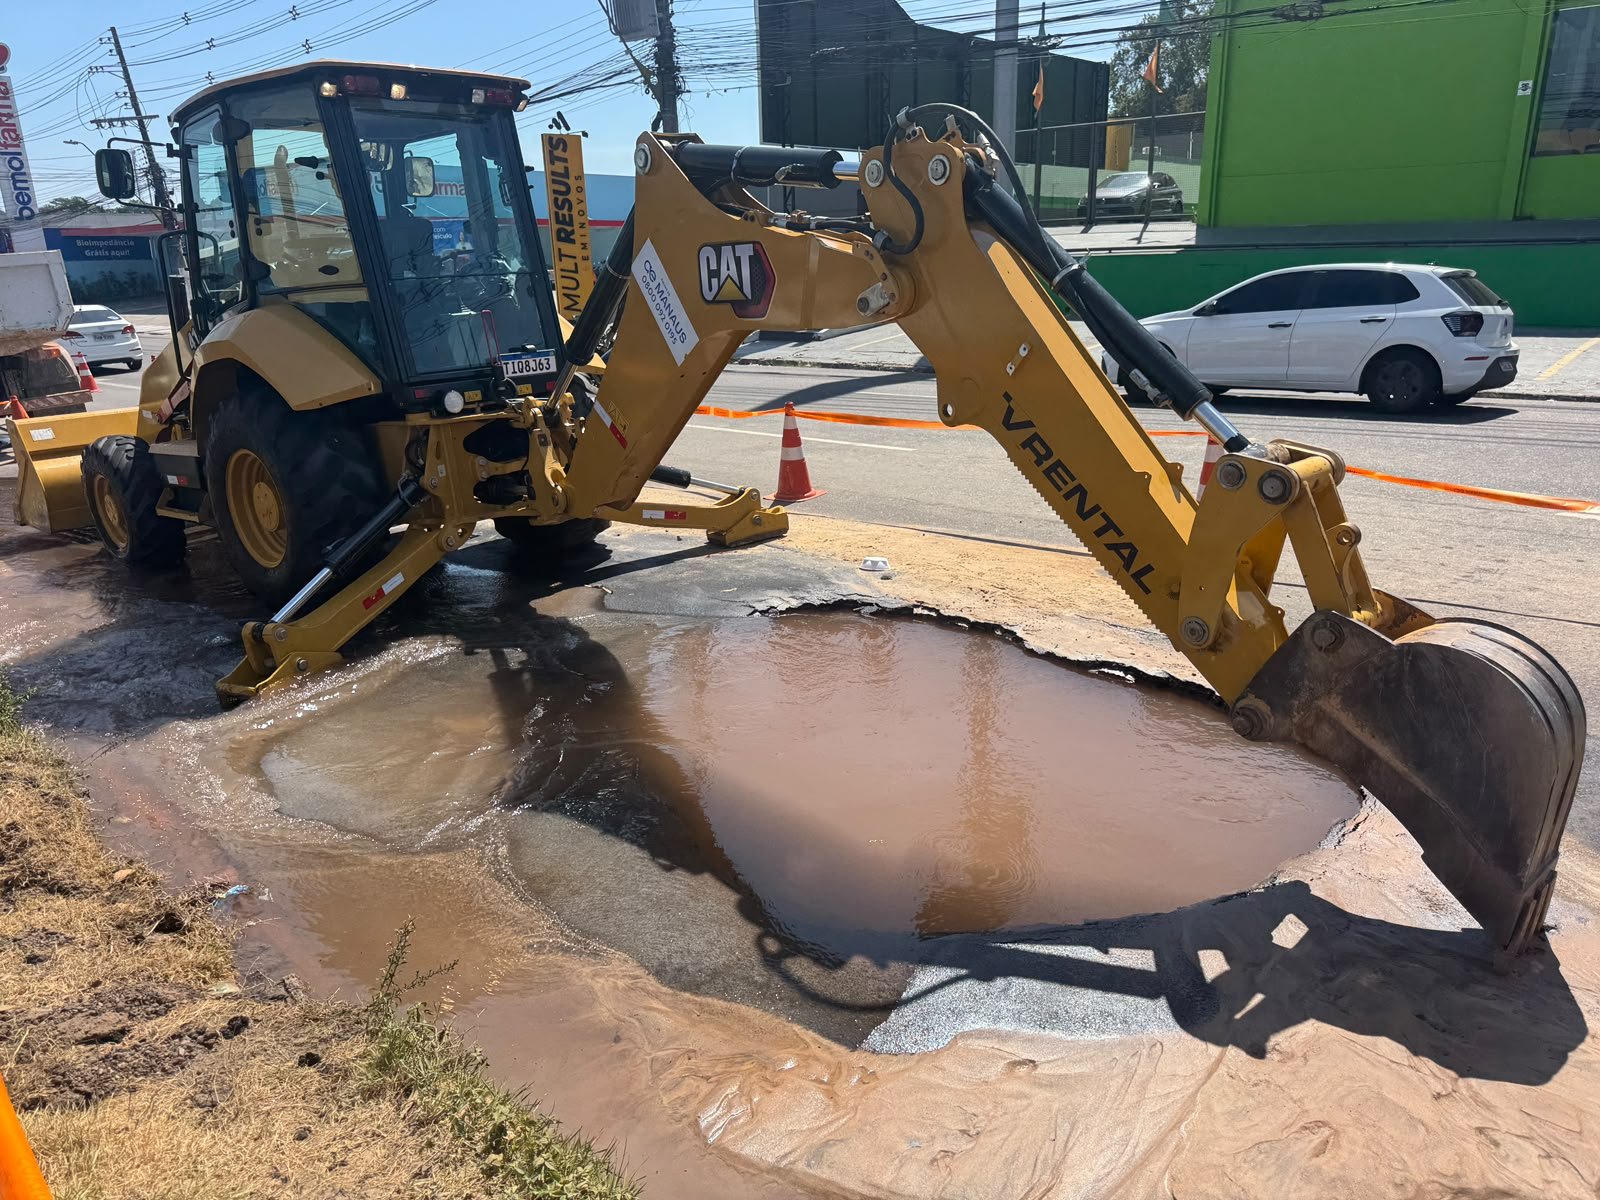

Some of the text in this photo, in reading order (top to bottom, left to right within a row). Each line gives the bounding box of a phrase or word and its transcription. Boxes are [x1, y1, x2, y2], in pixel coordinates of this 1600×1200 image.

[84, 249, 110, 257] Grátis
[548, 136, 582, 312] MULT RESULTS
[699, 243, 754, 301] CAT
[641, 275, 657, 303] 0800
[655, 302, 667, 323] 092
[664, 322, 678, 345] 0195
[654, 282, 687, 344] MANAUS
[503, 357, 551, 375] TIQ8J63
